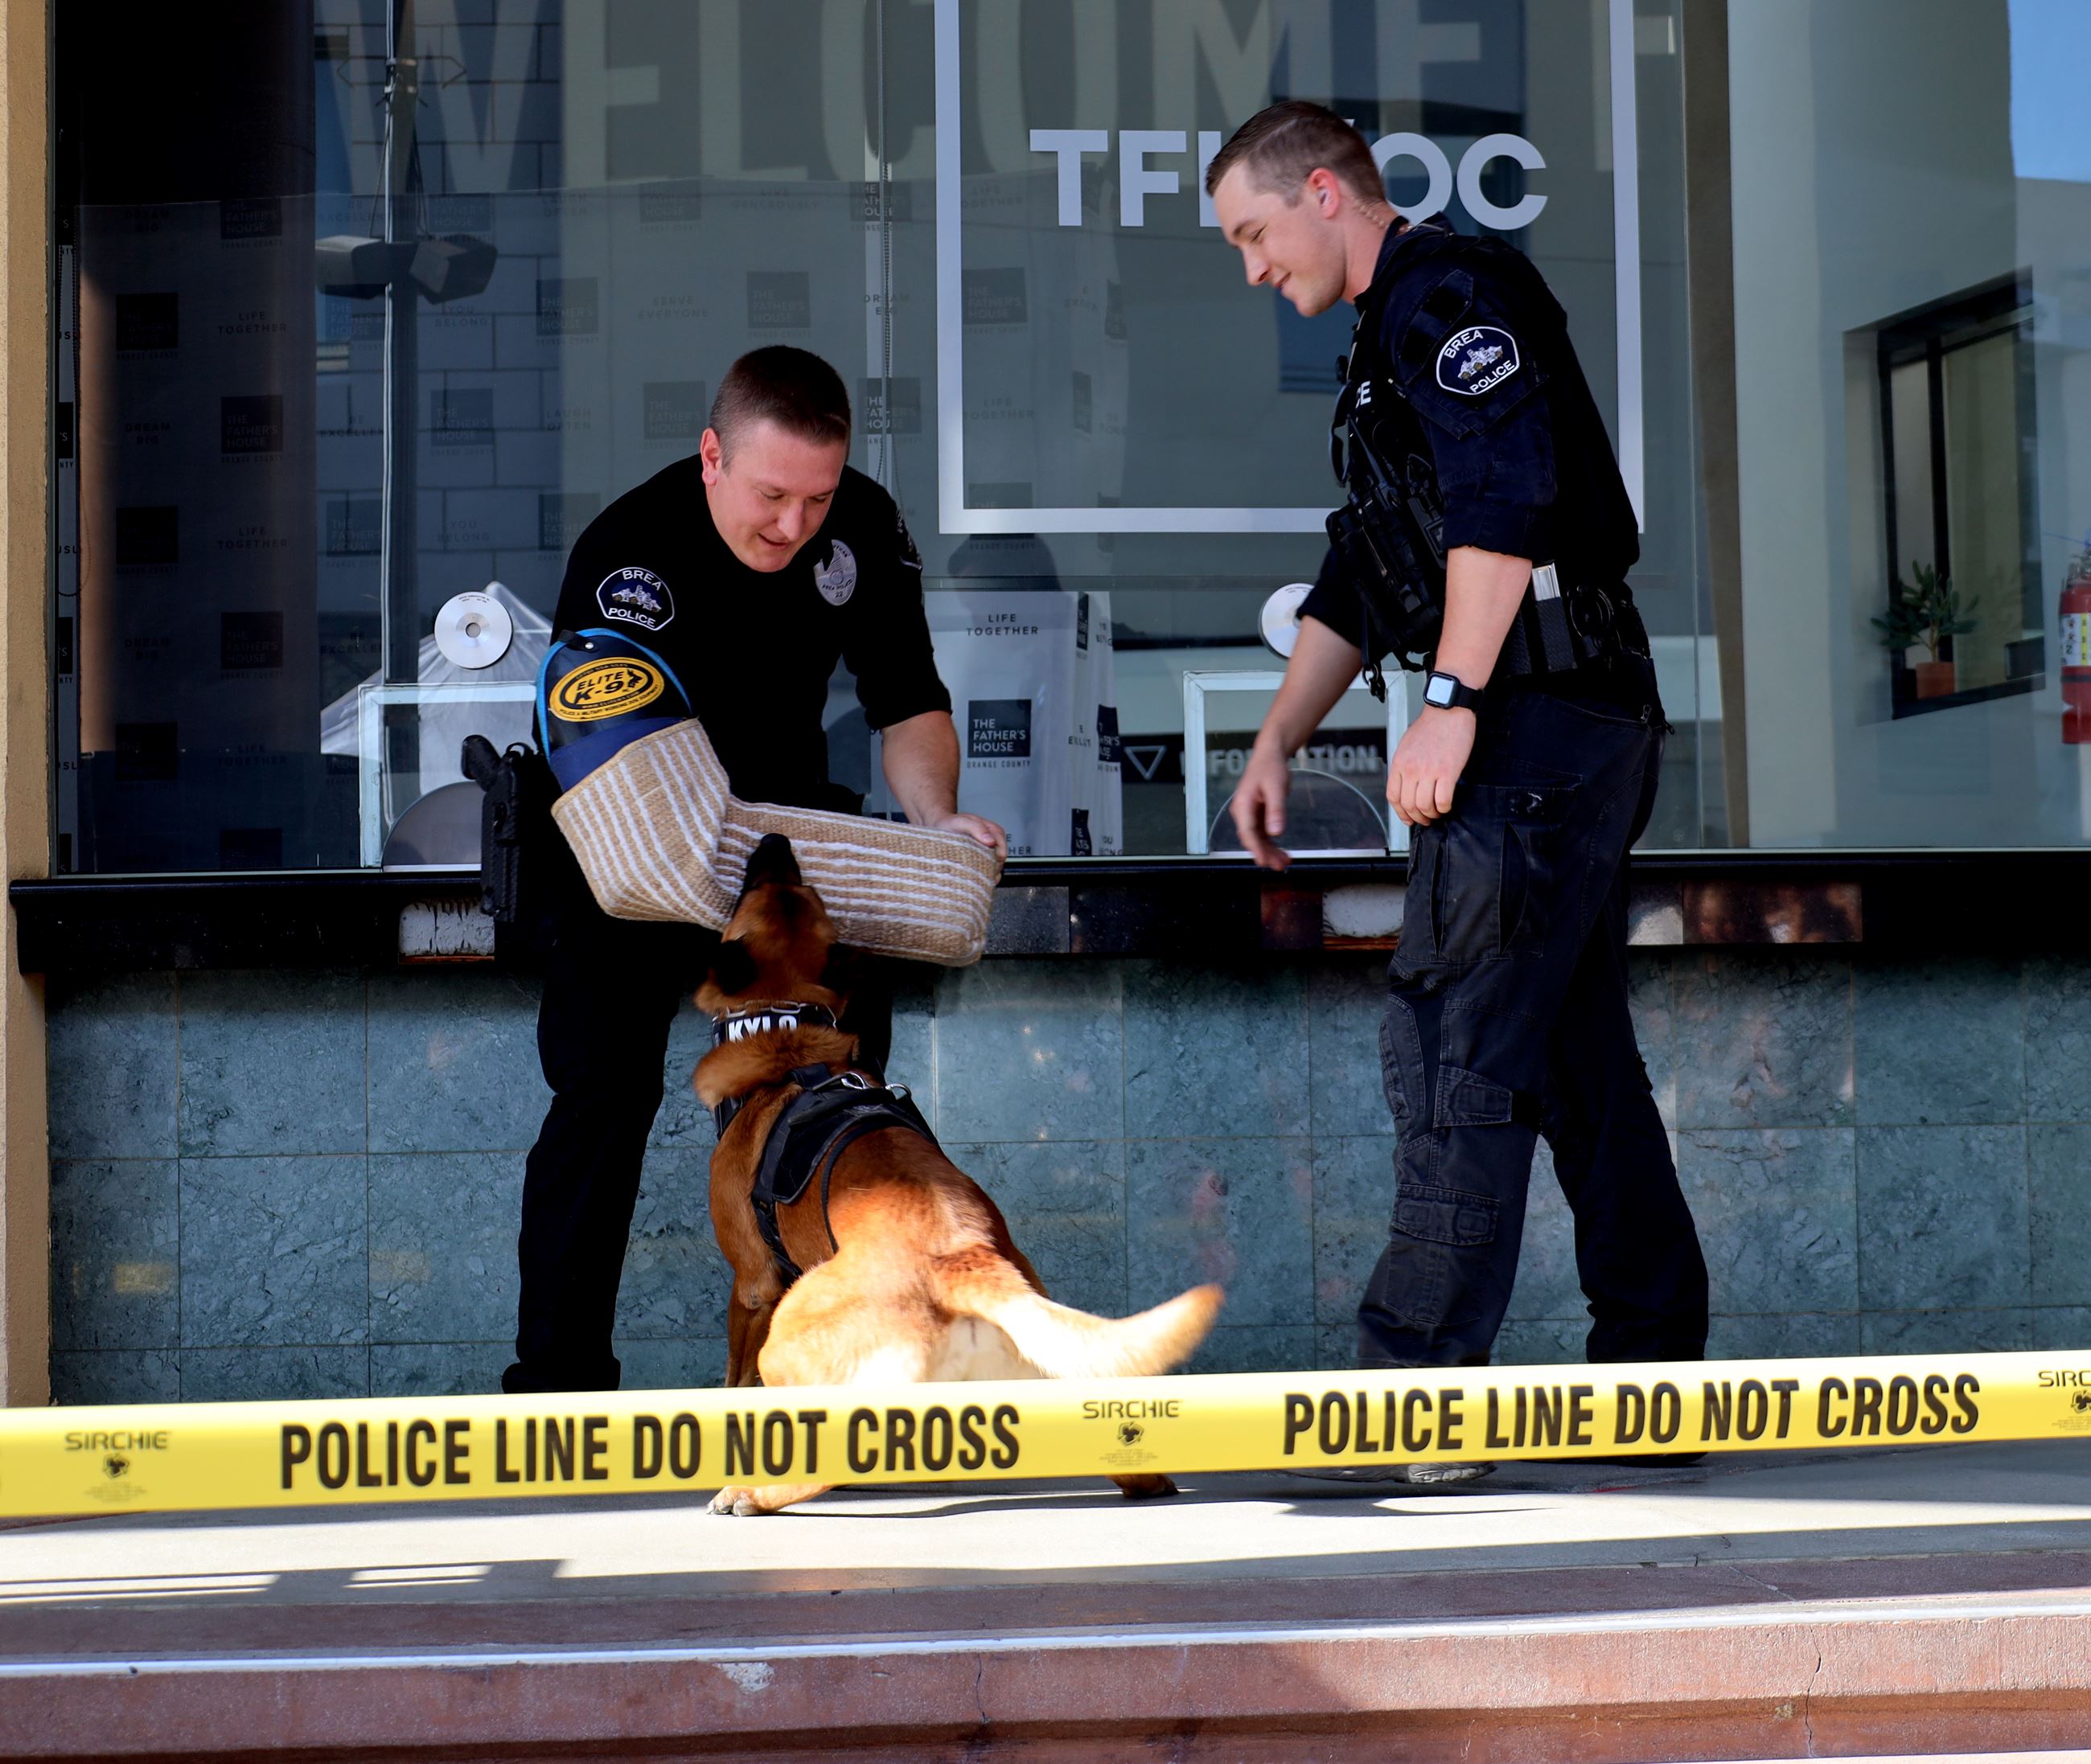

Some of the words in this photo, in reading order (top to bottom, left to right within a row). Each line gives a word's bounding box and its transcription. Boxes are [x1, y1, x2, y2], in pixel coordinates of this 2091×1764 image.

[238, 310, 266, 321] LIFE
[217, 322, 288, 335] TOGETHER
[1444, 330, 1484, 359] BREA
[1469, 359, 1515, 393] POLICE
[238, 526, 267, 536] LIFE
[217, 539, 289, 550] TOGETHER
[622, 569, 663, 592] BREA
[608, 607, 656, 629] POLICE
[988, 613, 1017, 623] LIFE
[966, 626, 1038, 637] TOGETHER
[577, 671, 624, 691] ELITE
[573, 680, 624, 704] K-9
[973, 718, 995, 728] THE
[973, 729, 1026, 741] FATHER'S
[973, 741, 1014, 753] HOUSE
[2039, 1370, 2091, 1387] SIRC
[1082, 1401, 1180, 1419] SIRCHIE
[1284, 1388, 1463, 1456] POLICE
[1485, 1385, 1594, 1448] LINE
[1614, 1381, 1681, 1444] DO
[1700, 1379, 1800, 1442] NOT
[1816, 1373, 1980, 1437] CROSS
[64, 1431, 168, 1450] SIRCHIE
[281, 1419, 470, 1490] POLICE
[495, 1416, 609, 1483] LINE
[632, 1412, 701, 1479] DO
[725, 1409, 827, 1477] NOT
[846, 1404, 1020, 1474] CROSS
